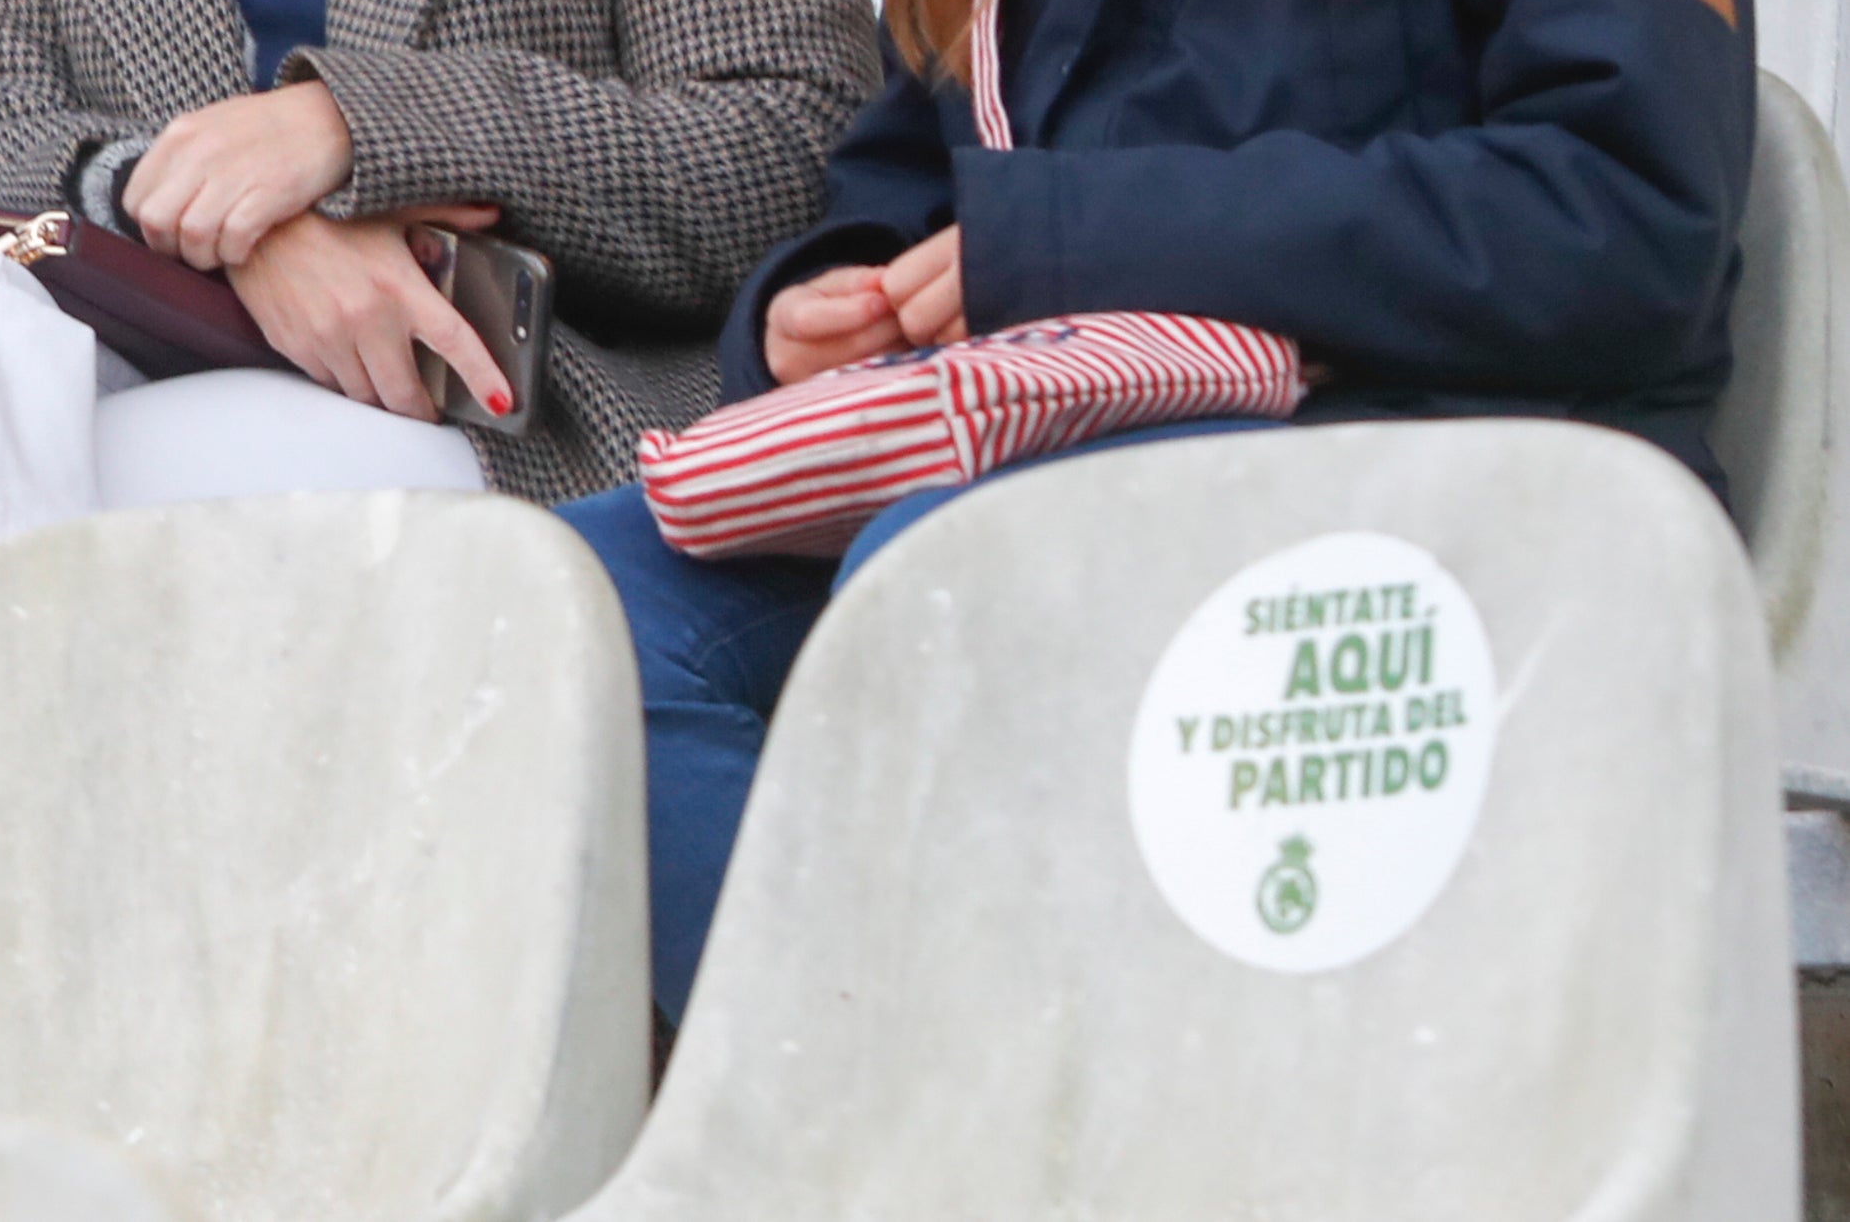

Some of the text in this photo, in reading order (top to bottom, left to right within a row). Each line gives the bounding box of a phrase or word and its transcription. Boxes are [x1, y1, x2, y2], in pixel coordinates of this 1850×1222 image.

[1244, 582, 1417, 637] SIÉNTATE
[1284, 603, 1439, 701] AQUÍ
[1176, 687, 1468, 755] Y DISFRUTA DEL
[1228, 738, 1449, 810] PARTIDO
